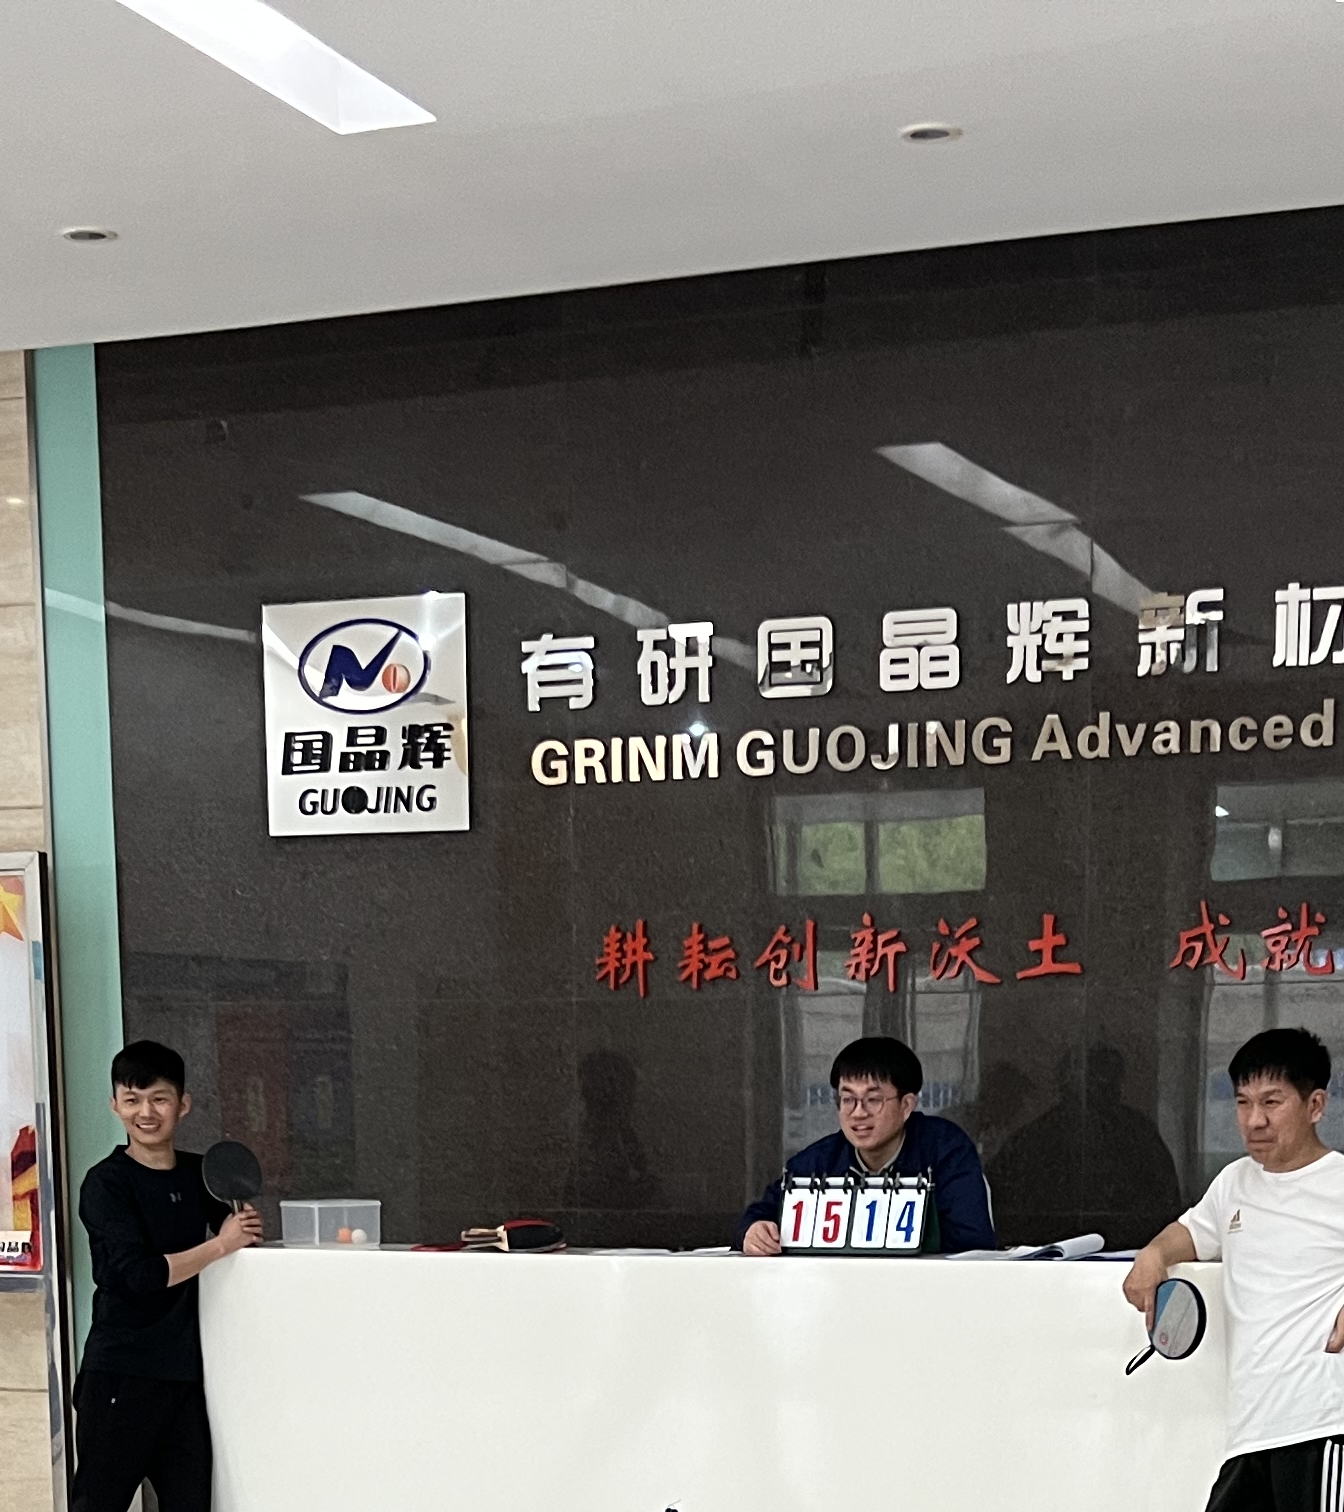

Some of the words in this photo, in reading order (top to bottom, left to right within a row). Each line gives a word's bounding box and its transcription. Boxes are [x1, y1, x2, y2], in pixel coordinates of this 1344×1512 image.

[282, 722, 455, 775] 国晶辉
[531, 730, 720, 787] GRINM
[735, 715, 1014, 777] GUOJING
[1032, 697, 1335, 763] Advanced
[299, 784, 438, 816] GUOJING
[594, 912, 1083, 1000] 耕耘创新沃土
